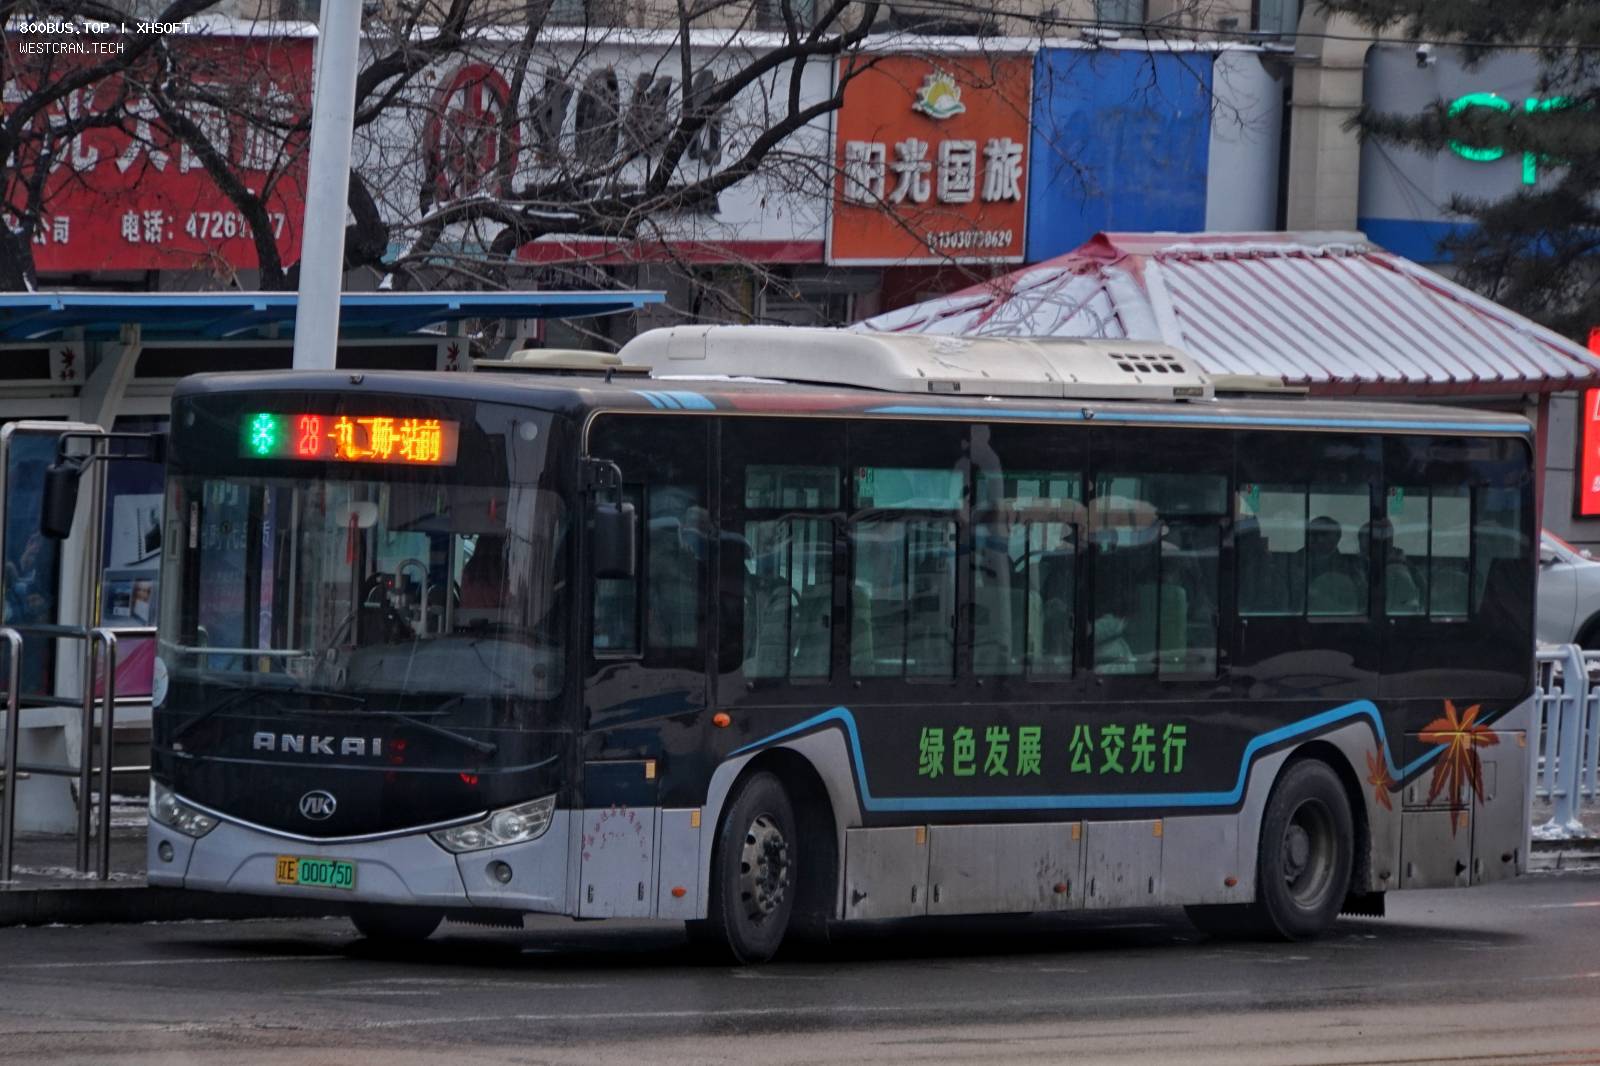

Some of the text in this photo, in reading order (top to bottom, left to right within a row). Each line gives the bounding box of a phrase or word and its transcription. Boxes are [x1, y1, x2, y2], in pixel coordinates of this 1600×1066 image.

[842, 138, 1024, 205] 阳光国旅
[186, 211, 286, 241] 47267
[299, 416, 320, 455] 28
[252, 731, 383, 756] ANKAI
[918, 723, 1188, 779] 绿色发展 公交先行
